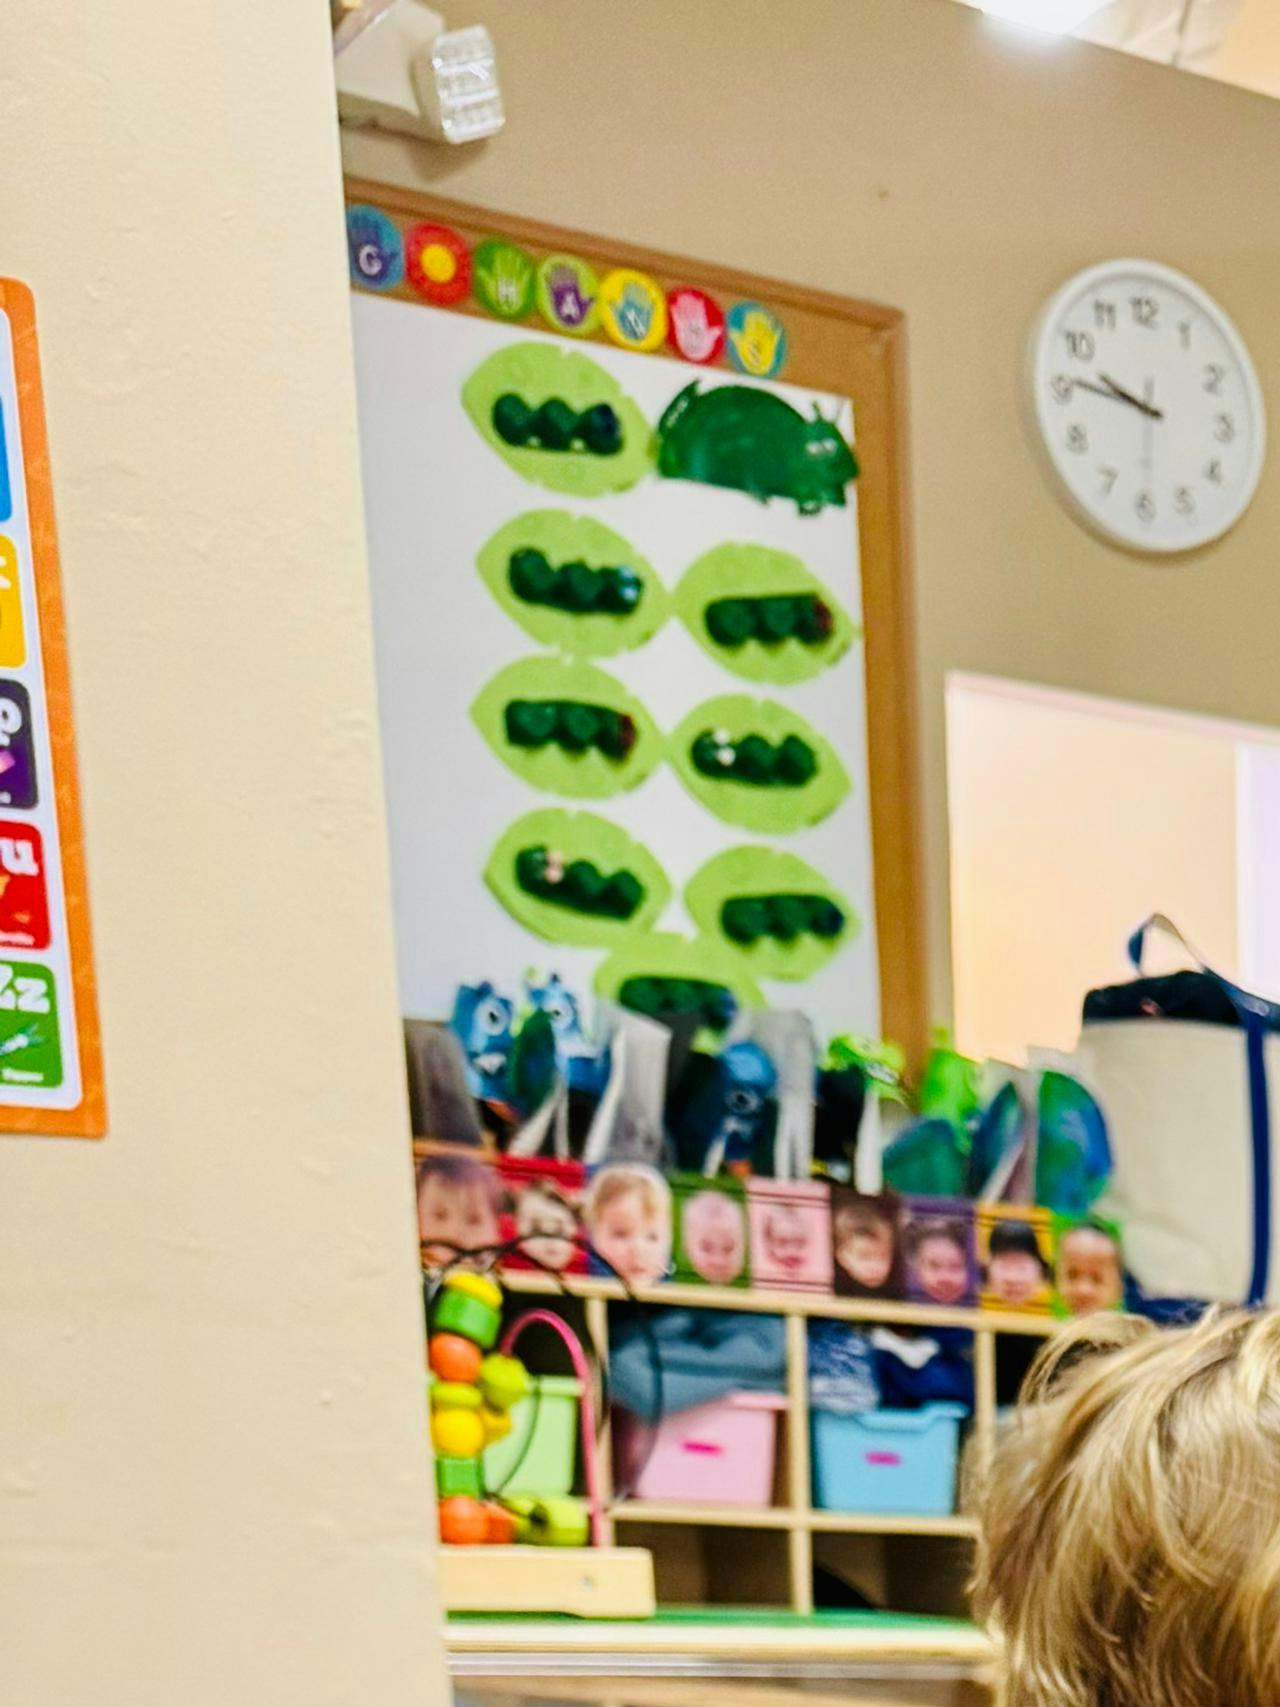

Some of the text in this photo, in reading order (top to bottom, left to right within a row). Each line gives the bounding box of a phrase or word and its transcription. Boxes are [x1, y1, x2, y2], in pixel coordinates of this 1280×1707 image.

[1094, 300, 1116, 330] 11
[1132, 298, 1159, 329] 12
[1065, 330, 1095, 361] 10
[1178, 321, 1191, 349] 1
[1203, 364, 1225, 394] 2
[1214, 414, 1235, 444] 3
[1099, 465, 1119, 494] 7
